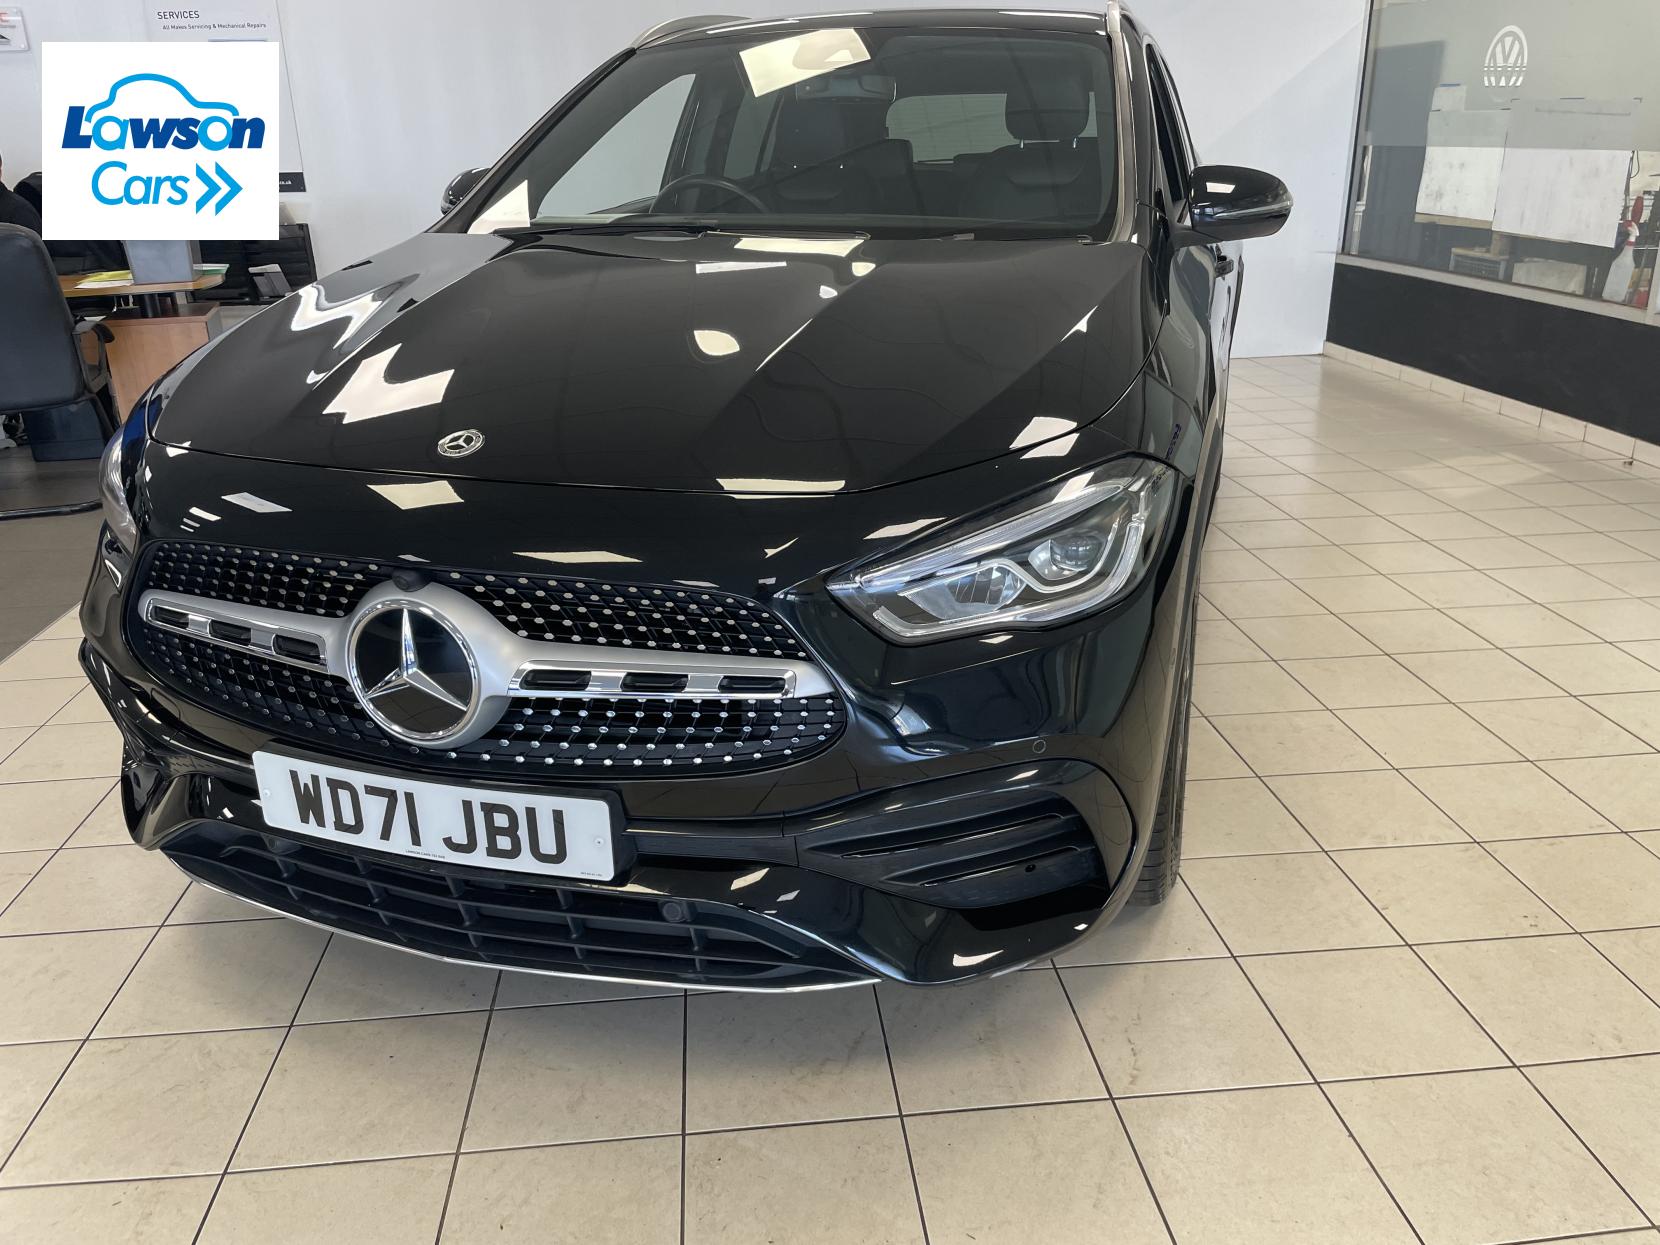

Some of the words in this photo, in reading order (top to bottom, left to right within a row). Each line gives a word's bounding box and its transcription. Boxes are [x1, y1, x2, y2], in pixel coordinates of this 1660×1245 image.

[157, 10, 200, 20] SERVICES
[289, 769, 422, 847] WD71
[442, 799, 568, 865] JBU
